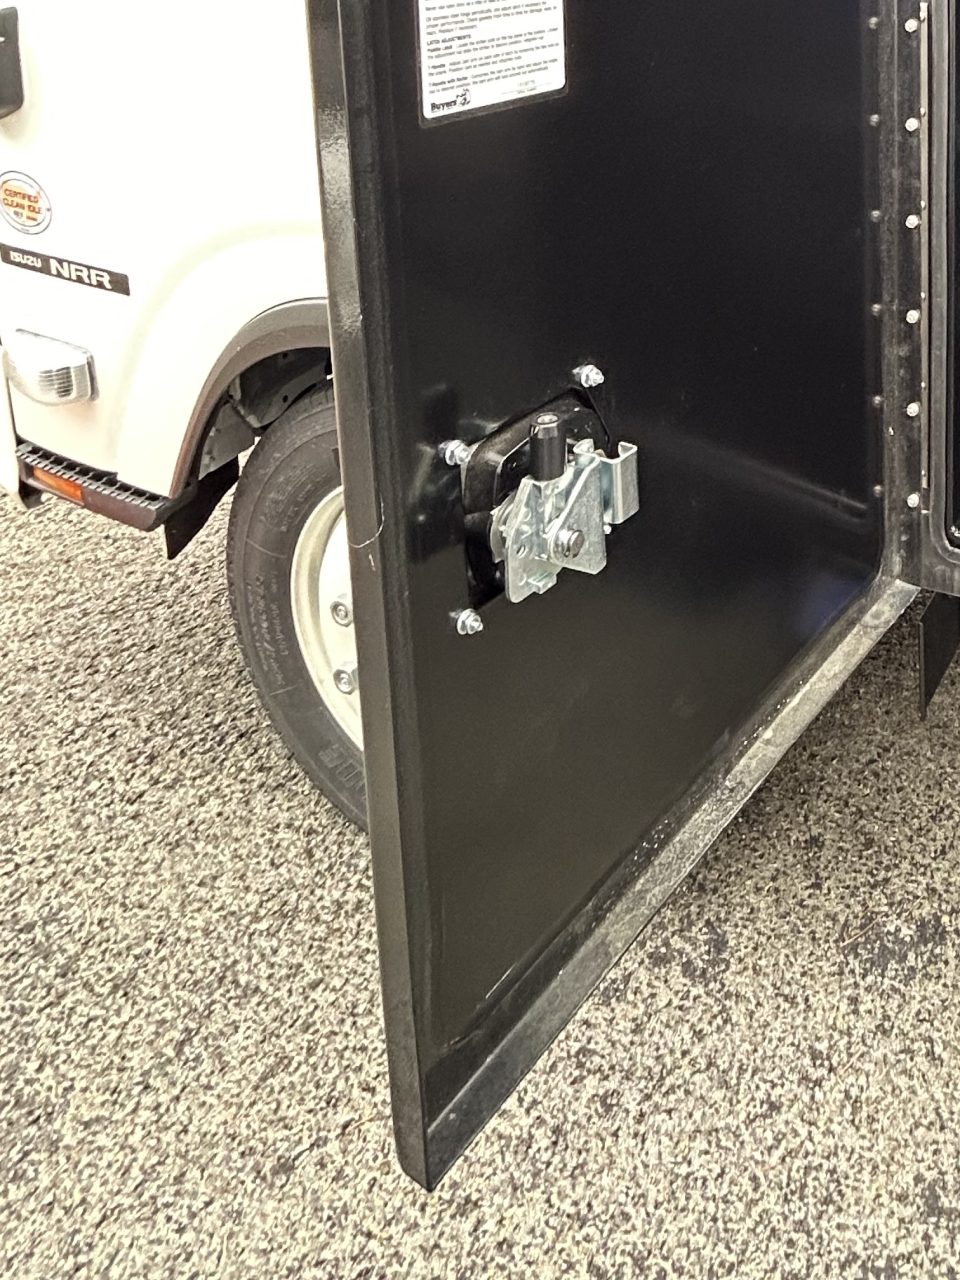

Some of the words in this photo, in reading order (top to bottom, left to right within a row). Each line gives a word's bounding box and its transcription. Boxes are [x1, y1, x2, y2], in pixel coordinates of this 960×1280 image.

[430, 99, 457, 112] Buyers
[4, 188, 39, 204] CERTIFIED
[2, 197, 26, 211] CLEAN
[27, 204, 43, 215] IDLE
[9, 250, 42, 268] ISUZU
[49, 258, 112, 290] NRR
